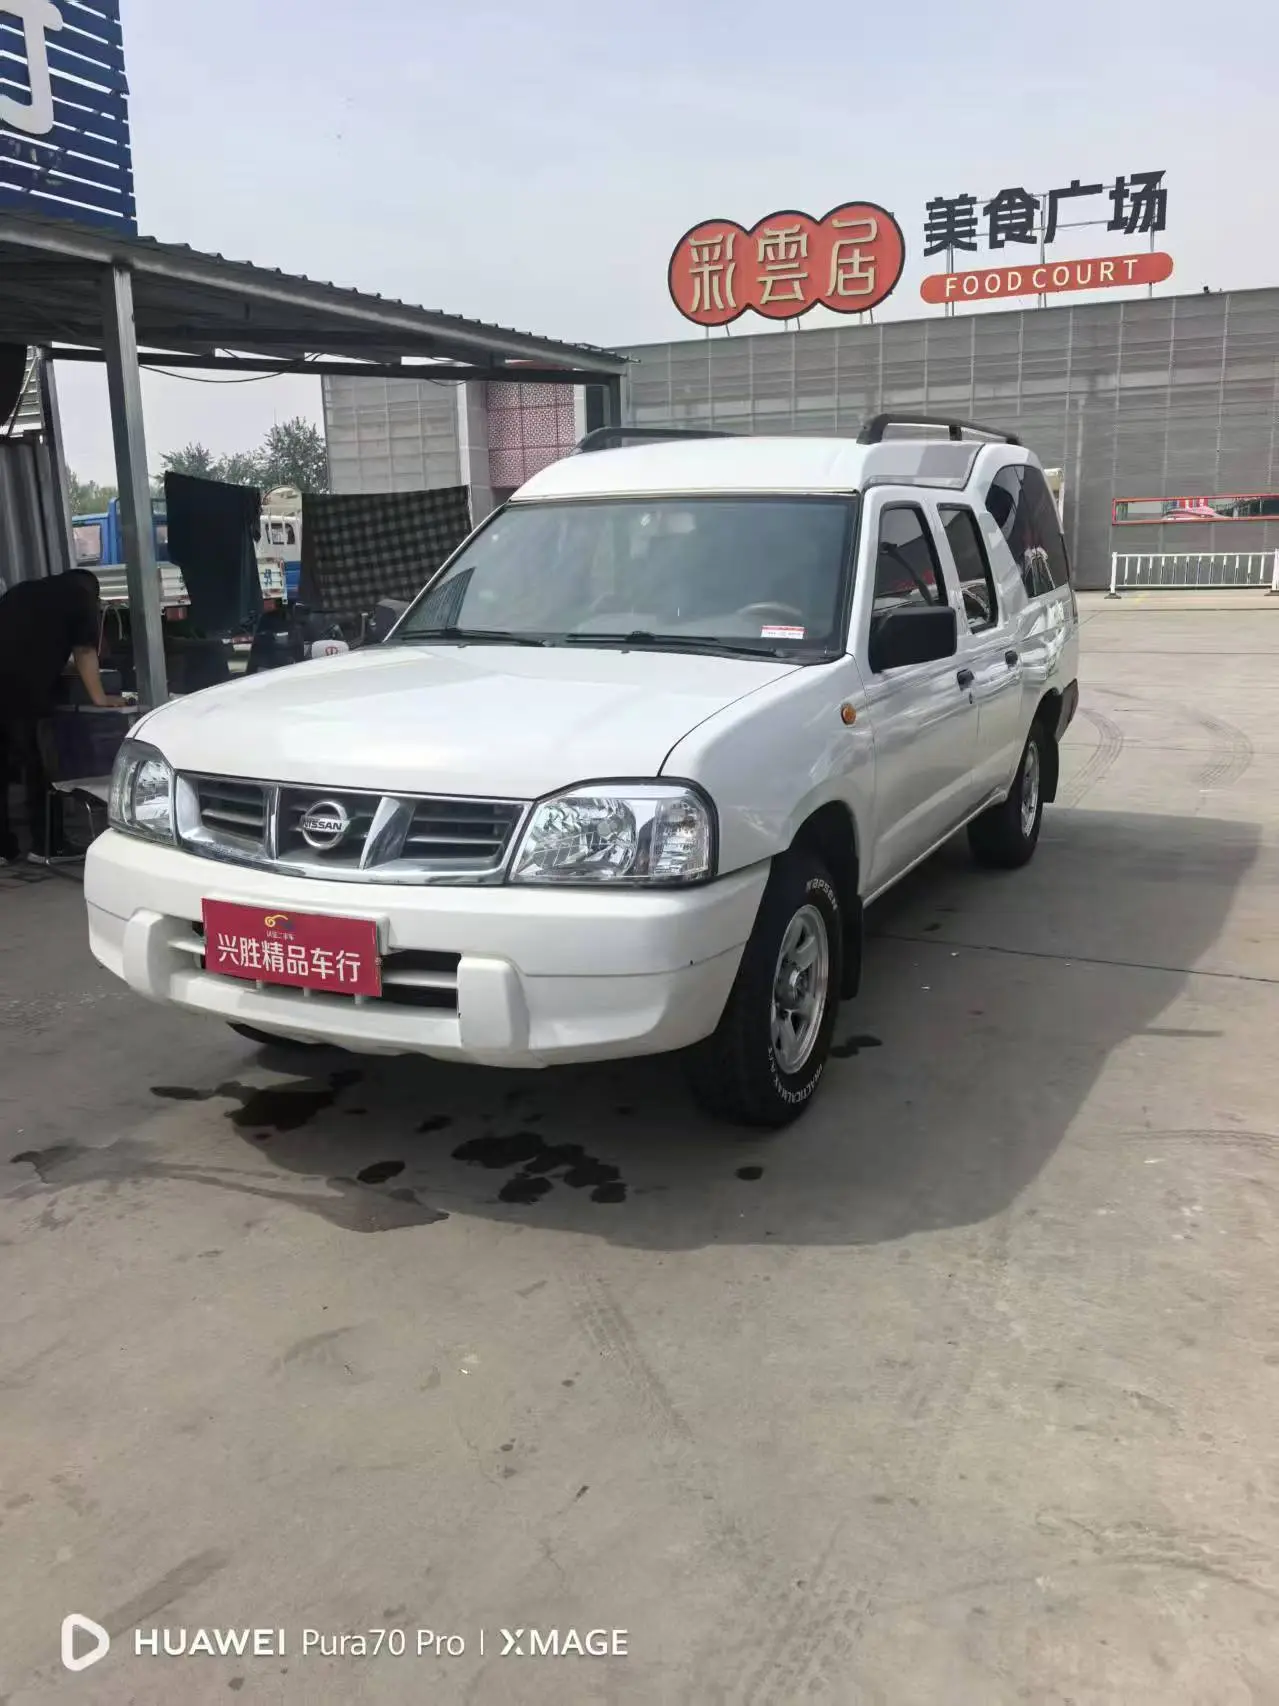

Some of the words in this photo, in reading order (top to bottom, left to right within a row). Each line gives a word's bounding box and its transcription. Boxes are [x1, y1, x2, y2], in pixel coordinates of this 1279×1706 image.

[923, 170, 1167, 256] 美食广场
[688, 217, 878, 312] 彩雲居
[945, 271, 1022, 297] FOOD
[1032, 259, 1138, 289] COURT
[303, 819, 343, 831] NISSAN
[217, 932, 361, 982] 兴胜精品车行
